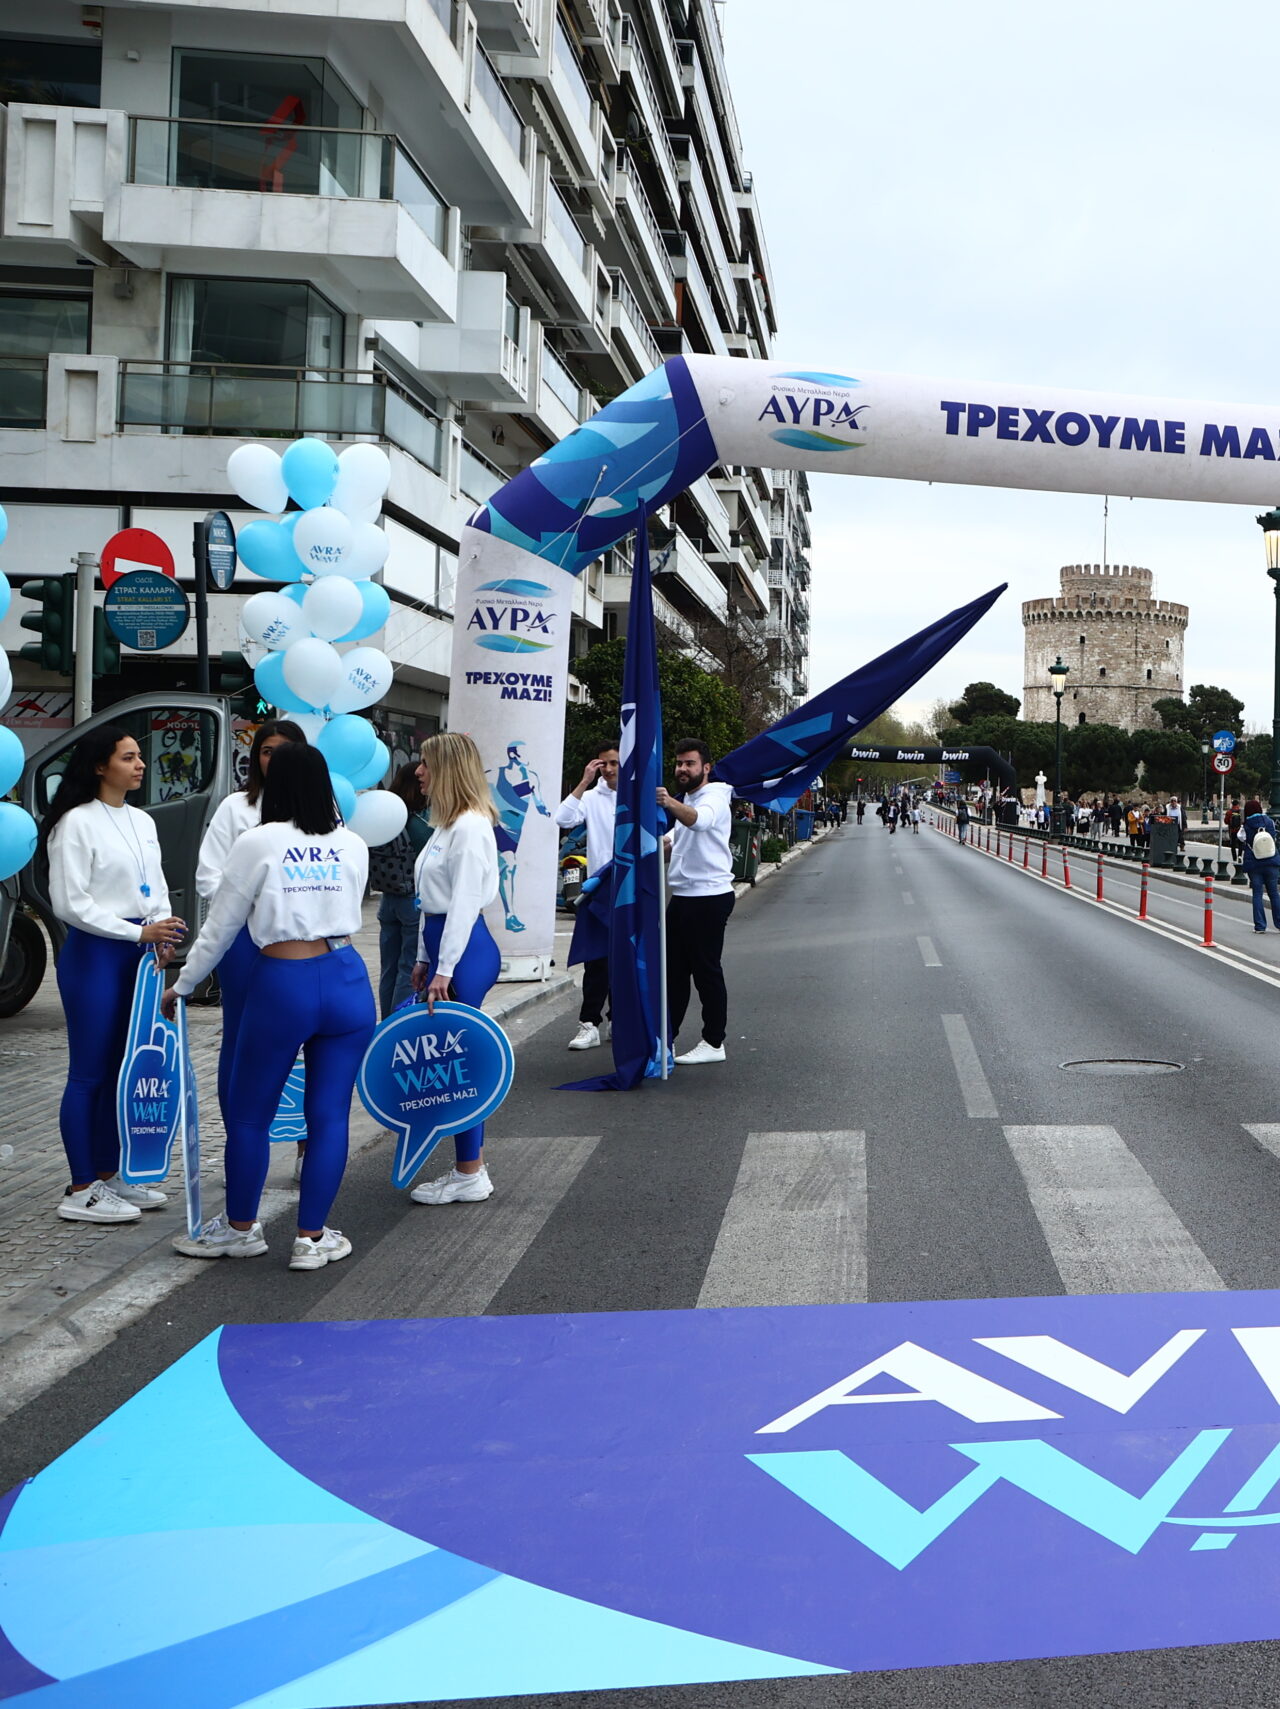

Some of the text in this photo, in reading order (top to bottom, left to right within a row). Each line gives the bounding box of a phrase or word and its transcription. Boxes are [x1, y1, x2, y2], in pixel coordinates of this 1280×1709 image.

[758, 394, 871, 430] ΑΥΡΑ
[940, 400, 1186, 455] ΤΡΕΧΟΥΜΕ
[310, 545, 344, 555] AVRA
[114, 586, 175, 594] ΣΤΡΑΤ. ΚΑΛΛΑΡΗ
[262, 616, 283, 641] AVRA
[467, 607, 557, 634] ΑΥΡΑ
[353, 667, 381, 688] AVRA
[465, 671, 553, 688] ΤΡΕΧΟΥΜΕ
[500, 687, 552, 702] ΜΑΖΙ!
[851, 748, 970, 761] bwin bwin bwin
[1216, 758, 1230, 768] 30
[282, 847, 344, 863] AVRA
[283, 864, 342, 881] WAVE
[282, 885, 322, 893] ΤΡΕΧΟΥΜΕ
[391, 1029, 468, 1068] AVRA
[393, 1058, 471, 1095] WAVE
[133, 1077, 172, 1098] AVRA
[399, 1087, 478, 1112] ΤΡΕΧΟΥΜΕ ΜΑΖΙ
[133, 1101, 168, 1122] WAVE
